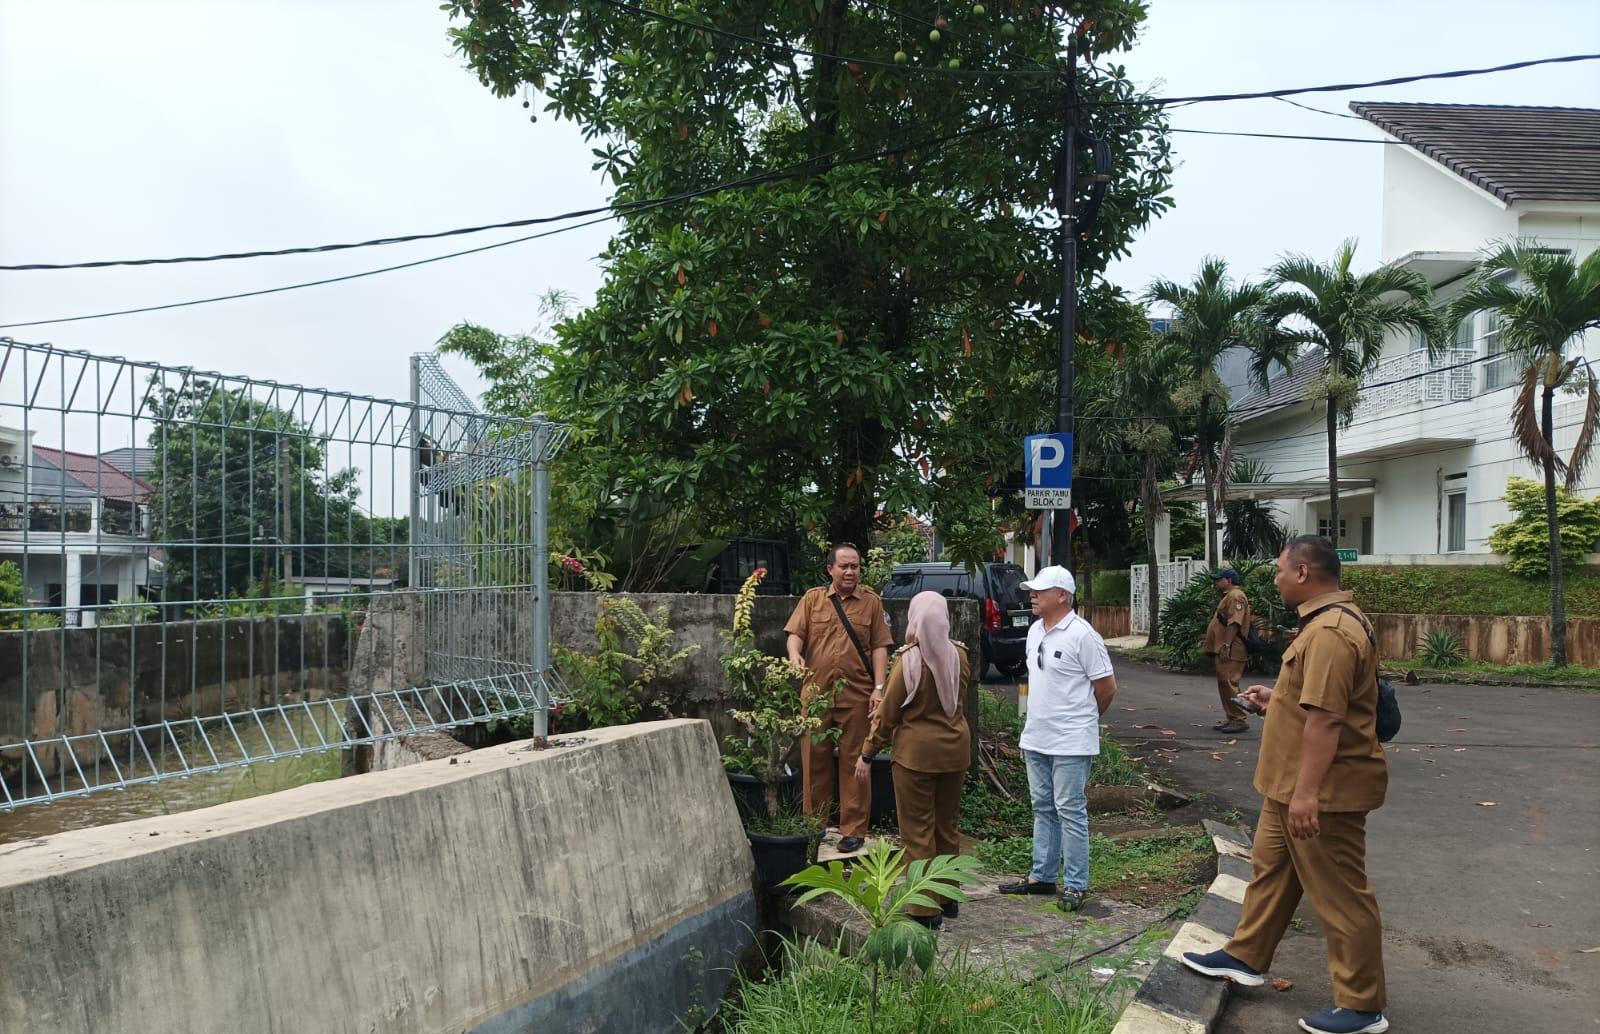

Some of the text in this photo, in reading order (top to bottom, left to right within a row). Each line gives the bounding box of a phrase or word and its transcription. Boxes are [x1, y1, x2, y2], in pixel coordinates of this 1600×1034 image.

[1030, 438, 1064, 486] P
[1027, 489, 1069, 498] PARKIR TAMU
[1033, 498, 1063, 506] BLOK C
